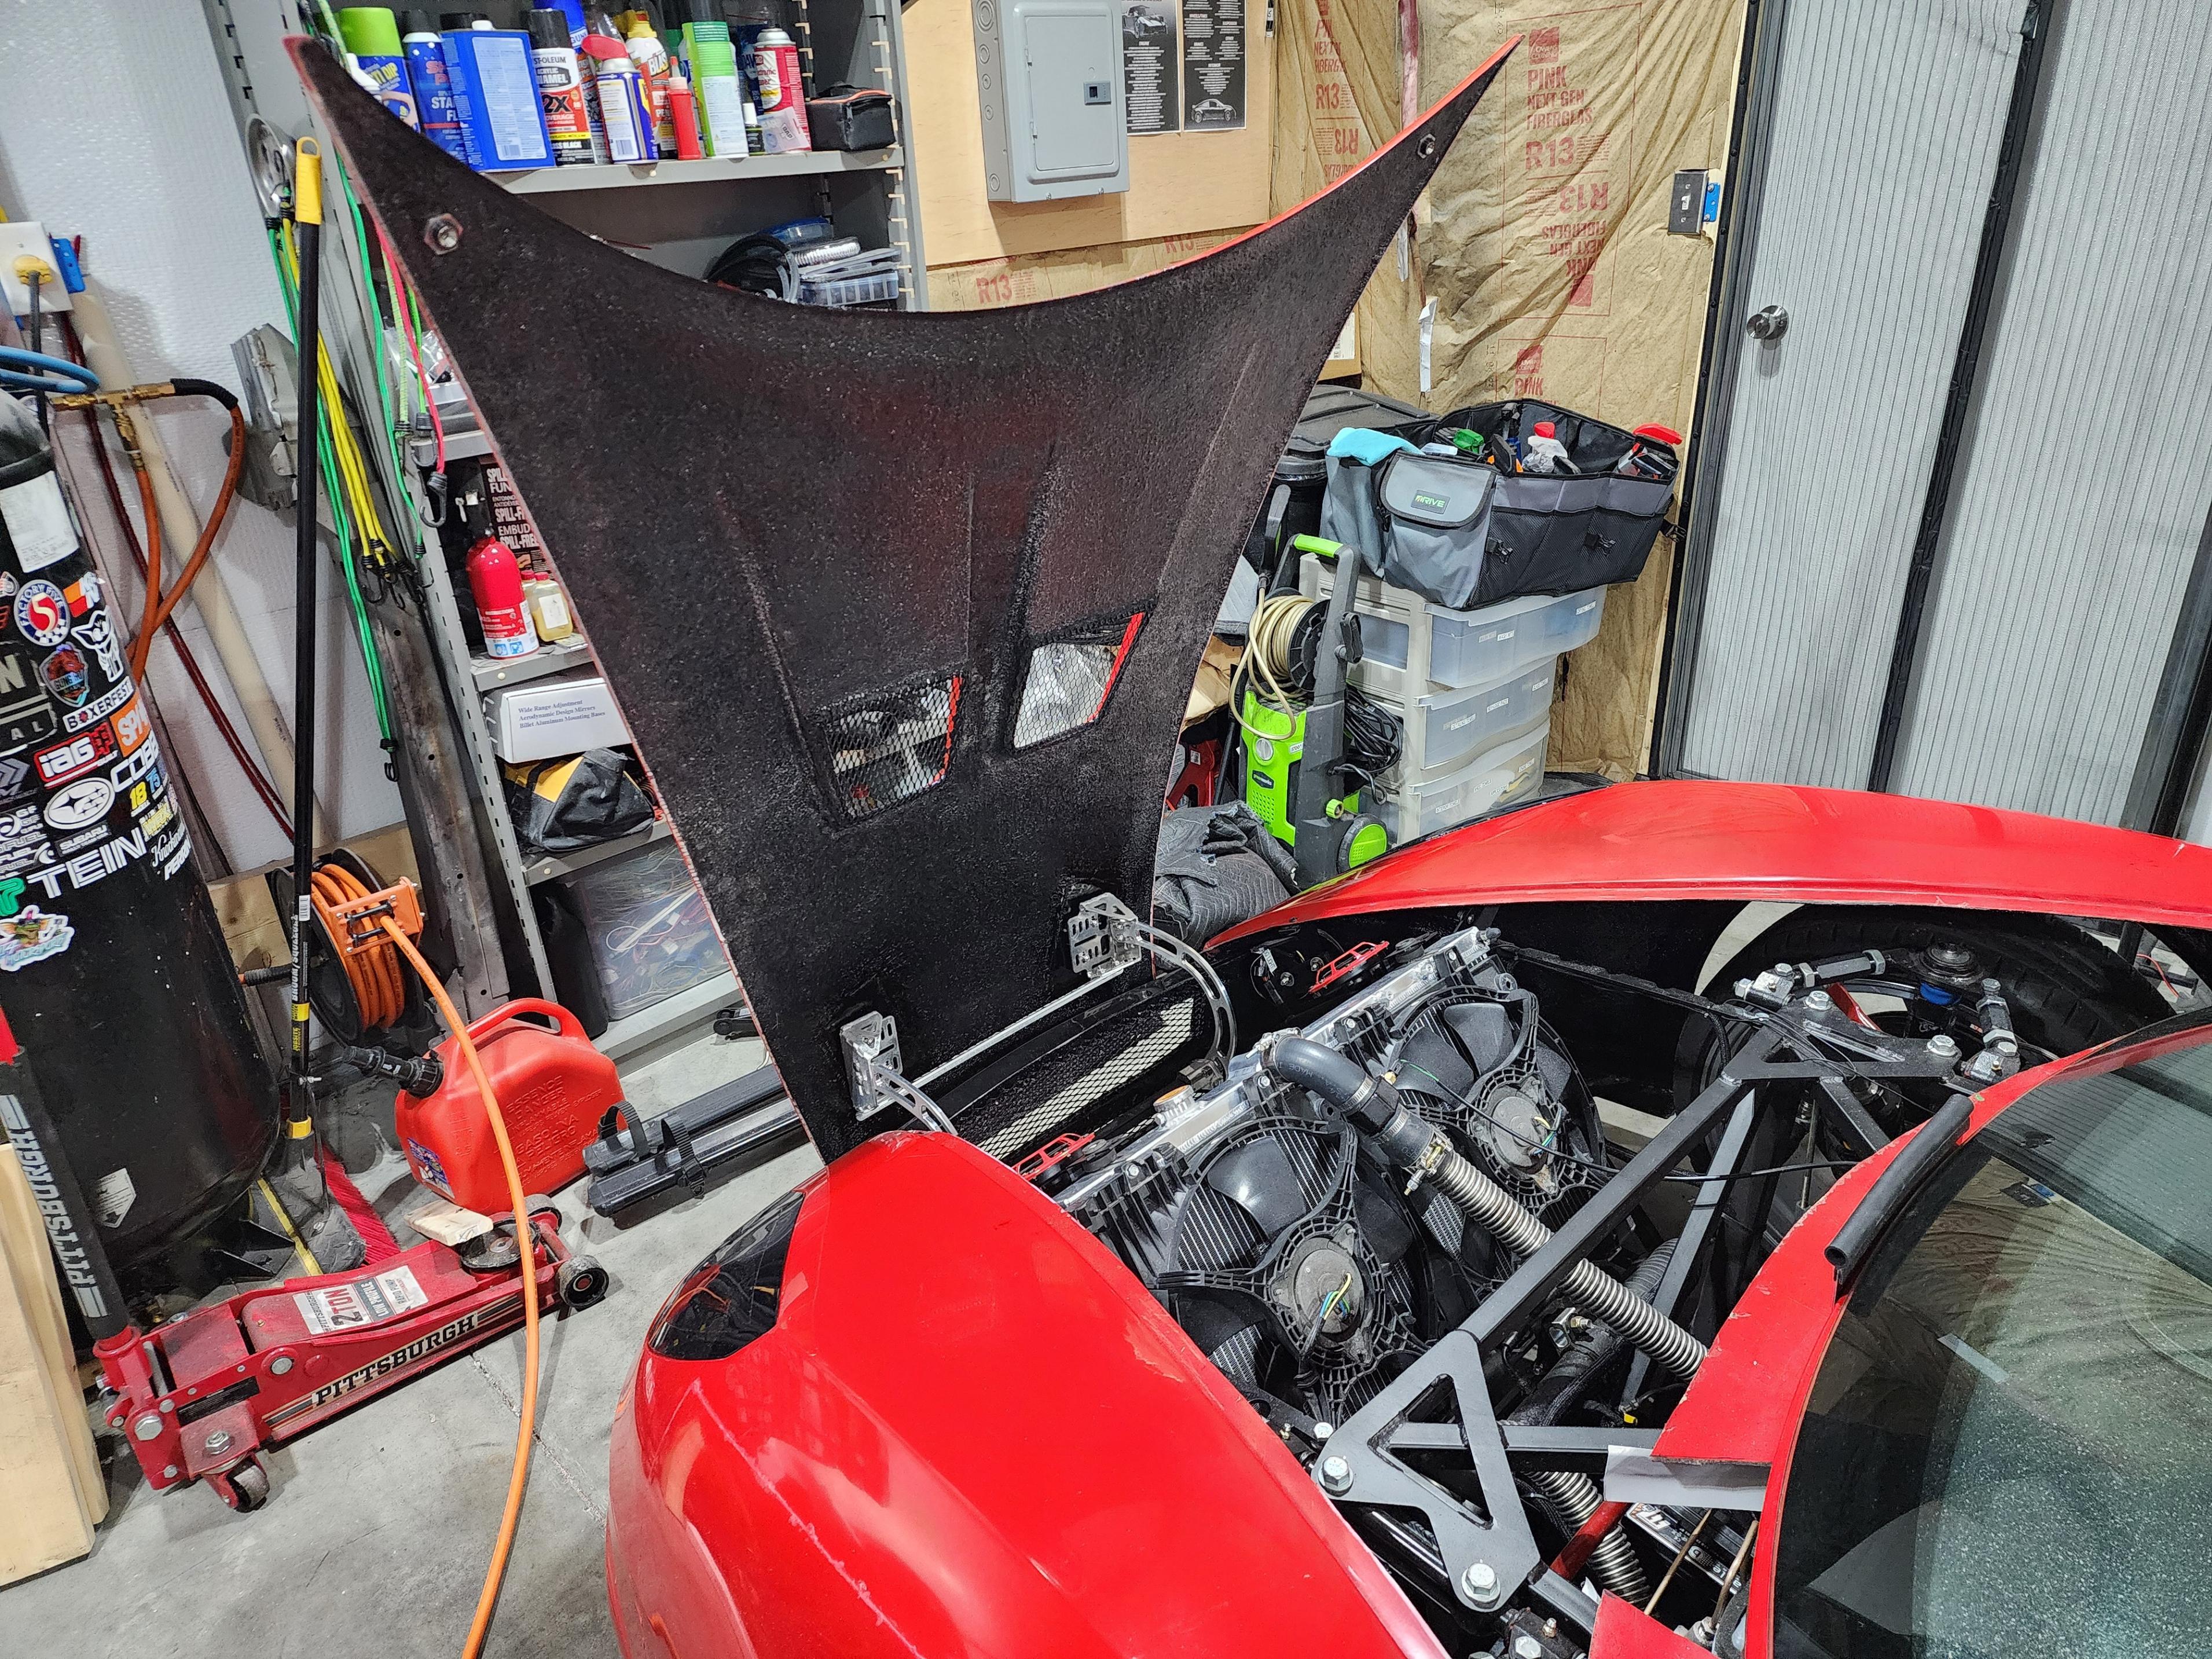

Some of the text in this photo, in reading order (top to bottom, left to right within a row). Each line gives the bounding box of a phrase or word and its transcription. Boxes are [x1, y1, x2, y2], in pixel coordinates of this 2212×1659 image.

[1527, 65, 1567, 91] PINK
[542, 94, 572, 113] 2X
[1315, 82, 1340, 109] R13
[1527, 89, 1586, 110] NEXT GEN
[1334, 128, 1359, 155] R13
[1525, 137, 1575, 170] R13
[1560, 182, 1608, 214] R13
[976, 274, 1013, 304] R13
[1514, 377, 1543, 396] PINK
[498, 523, 530, 536] EMBUD
[18, 584, 45, 626] FACTORY
[519, 712, 555, 721] Aerodynamic
[553, 700, 583, 708] Adjustment
[535, 718, 564, 726] Aluminum
[130, 781, 148, 810] 18
[60, 825, 107, 850] SUBARU
[27, 826, 148, 899] TEIN
[516, 1114, 579, 1155] GASOLINA
[526, 1126, 577, 1158] PELIGRO
[8, 1130, 96, 1288] PITTSBURGH
[306, 1295, 330, 1330] PITTSBURGH
[324, 1288, 364, 1326] 2 TON
[316, 1314, 479, 1406] PITTSBURGH
